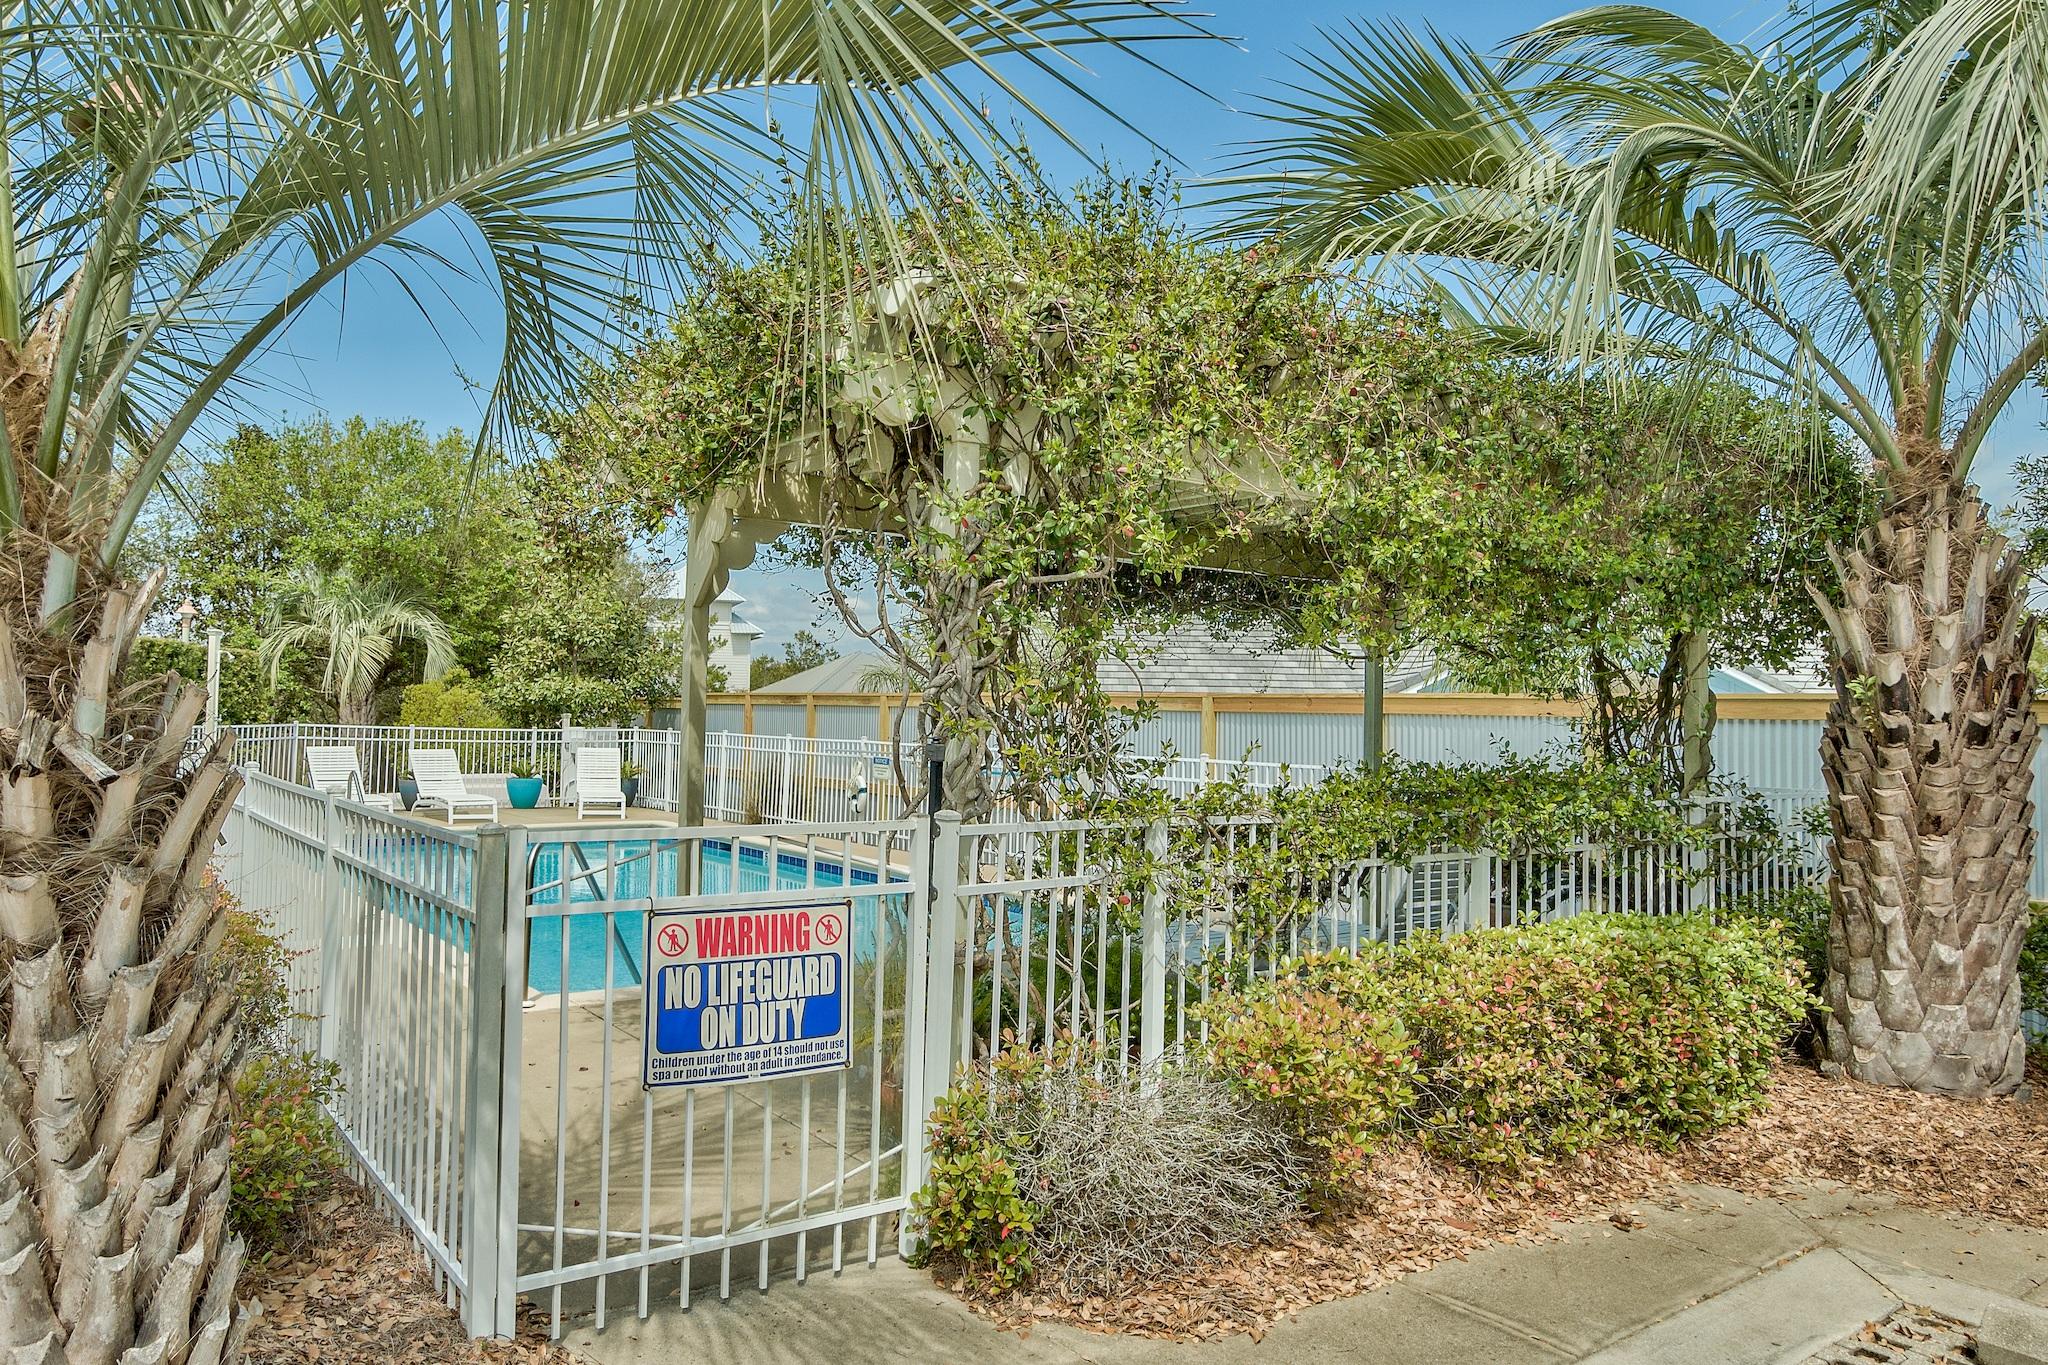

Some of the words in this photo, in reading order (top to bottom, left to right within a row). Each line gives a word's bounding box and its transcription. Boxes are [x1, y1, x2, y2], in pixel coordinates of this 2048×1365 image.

[695, 912, 810, 958] WARNING
[665, 965, 701, 1009] NO
[707, 955, 836, 1006] LIFEGUARD
[700, 1005, 736, 1050] ON
[742, 998, 806, 1045] DUTY
[652, 1057, 694, 1069] Children
[697, 1054, 725, 1066] under
[727, 1051, 742, 1062] the
[744, 1051, 761, 1061] age
[763, 1047, 771, 1058] of
[773, 1046, 782, 1056] 14
[784, 1042, 813, 1055] should
[814, 1040, 828, 1050] not
[830, 1039, 845, 1049] use
[652, 1071, 671, 1081] spa
[673, 1070, 683, 1079] or
[686, 1066, 707, 1079] pool
[709, 1062, 745, 1076] without
[747, 1062, 758, 1072] an
[760, 1058, 783, 1070] adult
[784, 1056, 793, 1066] in
[794, 1051, 843, 1065] attendance.
